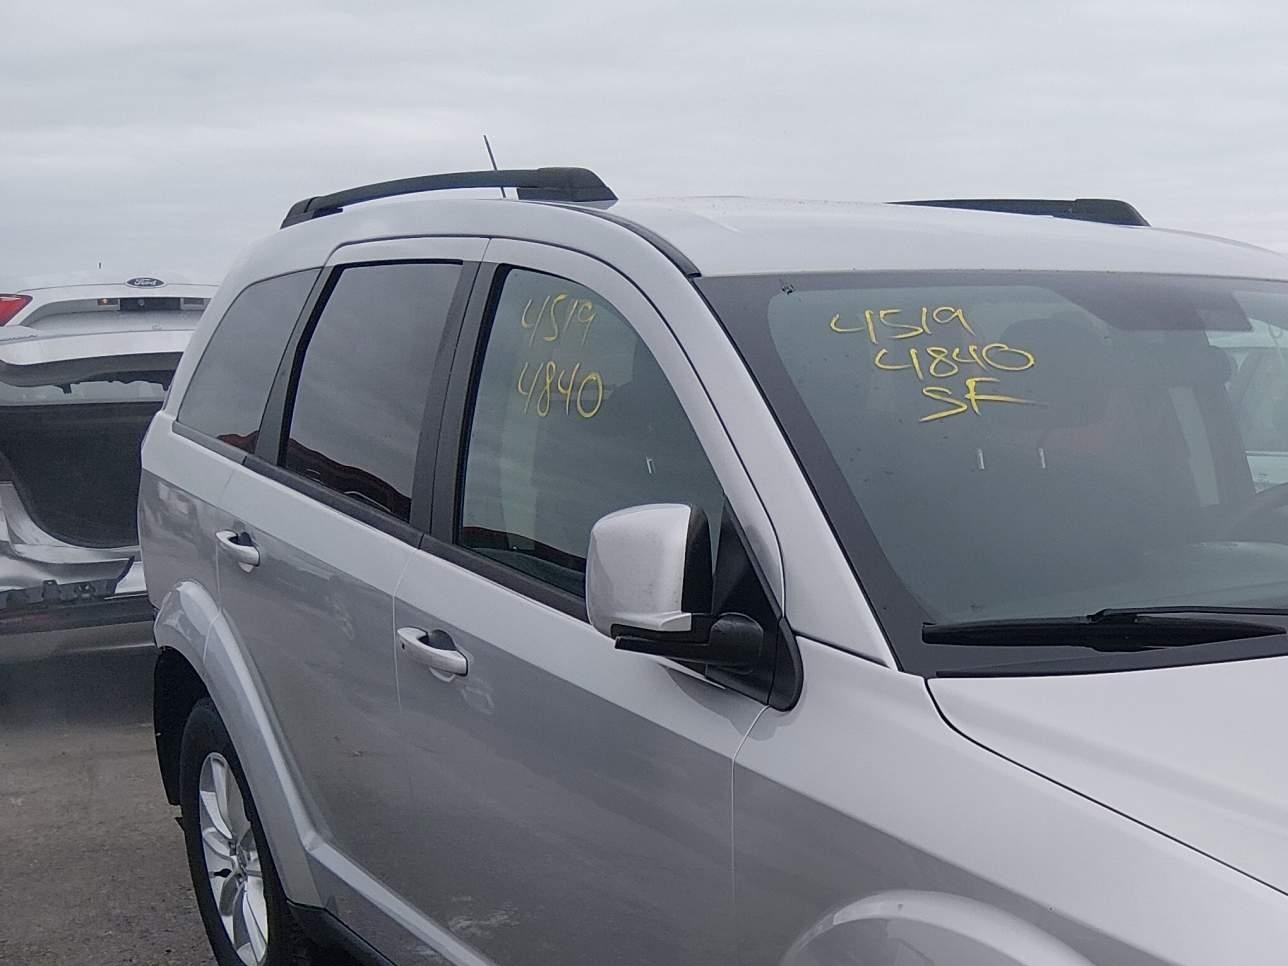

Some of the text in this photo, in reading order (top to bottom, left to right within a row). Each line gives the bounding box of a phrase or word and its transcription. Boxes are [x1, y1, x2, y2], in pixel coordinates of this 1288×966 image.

[521, 293, 596, 347] 4519
[830, 307, 976, 344] 4519
[874, 343, 1036, 380] 4840
[518, 361, 602, 417] 4840
